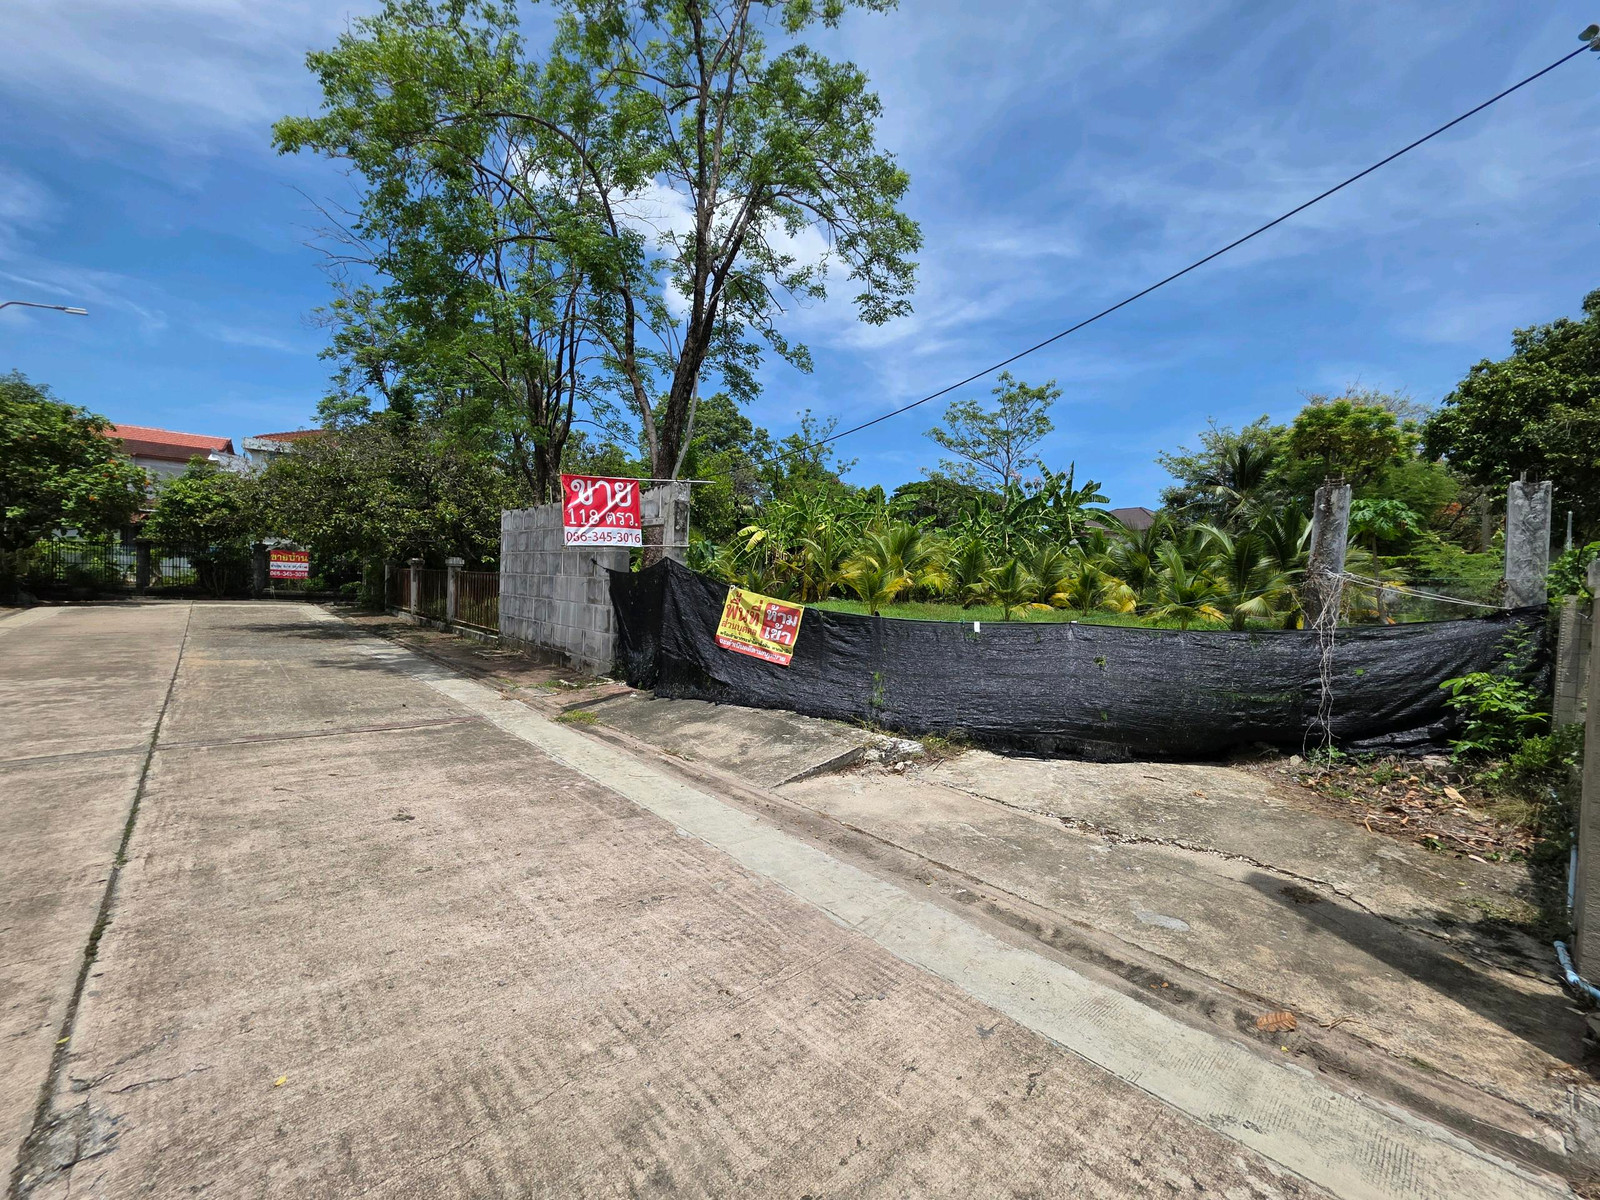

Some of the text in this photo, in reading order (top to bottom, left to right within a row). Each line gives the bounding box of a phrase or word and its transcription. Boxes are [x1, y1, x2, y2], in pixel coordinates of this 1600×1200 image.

[568, 479, 635, 508] ขาย
[567, 507, 600, 525] 118
[271, 552, 309, 562] ขายบ้าน
[725, 590, 764, 626] พื้นที่
[766, 604, 798, 627] ห้าม
[764, 622, 792, 645] เข้า
